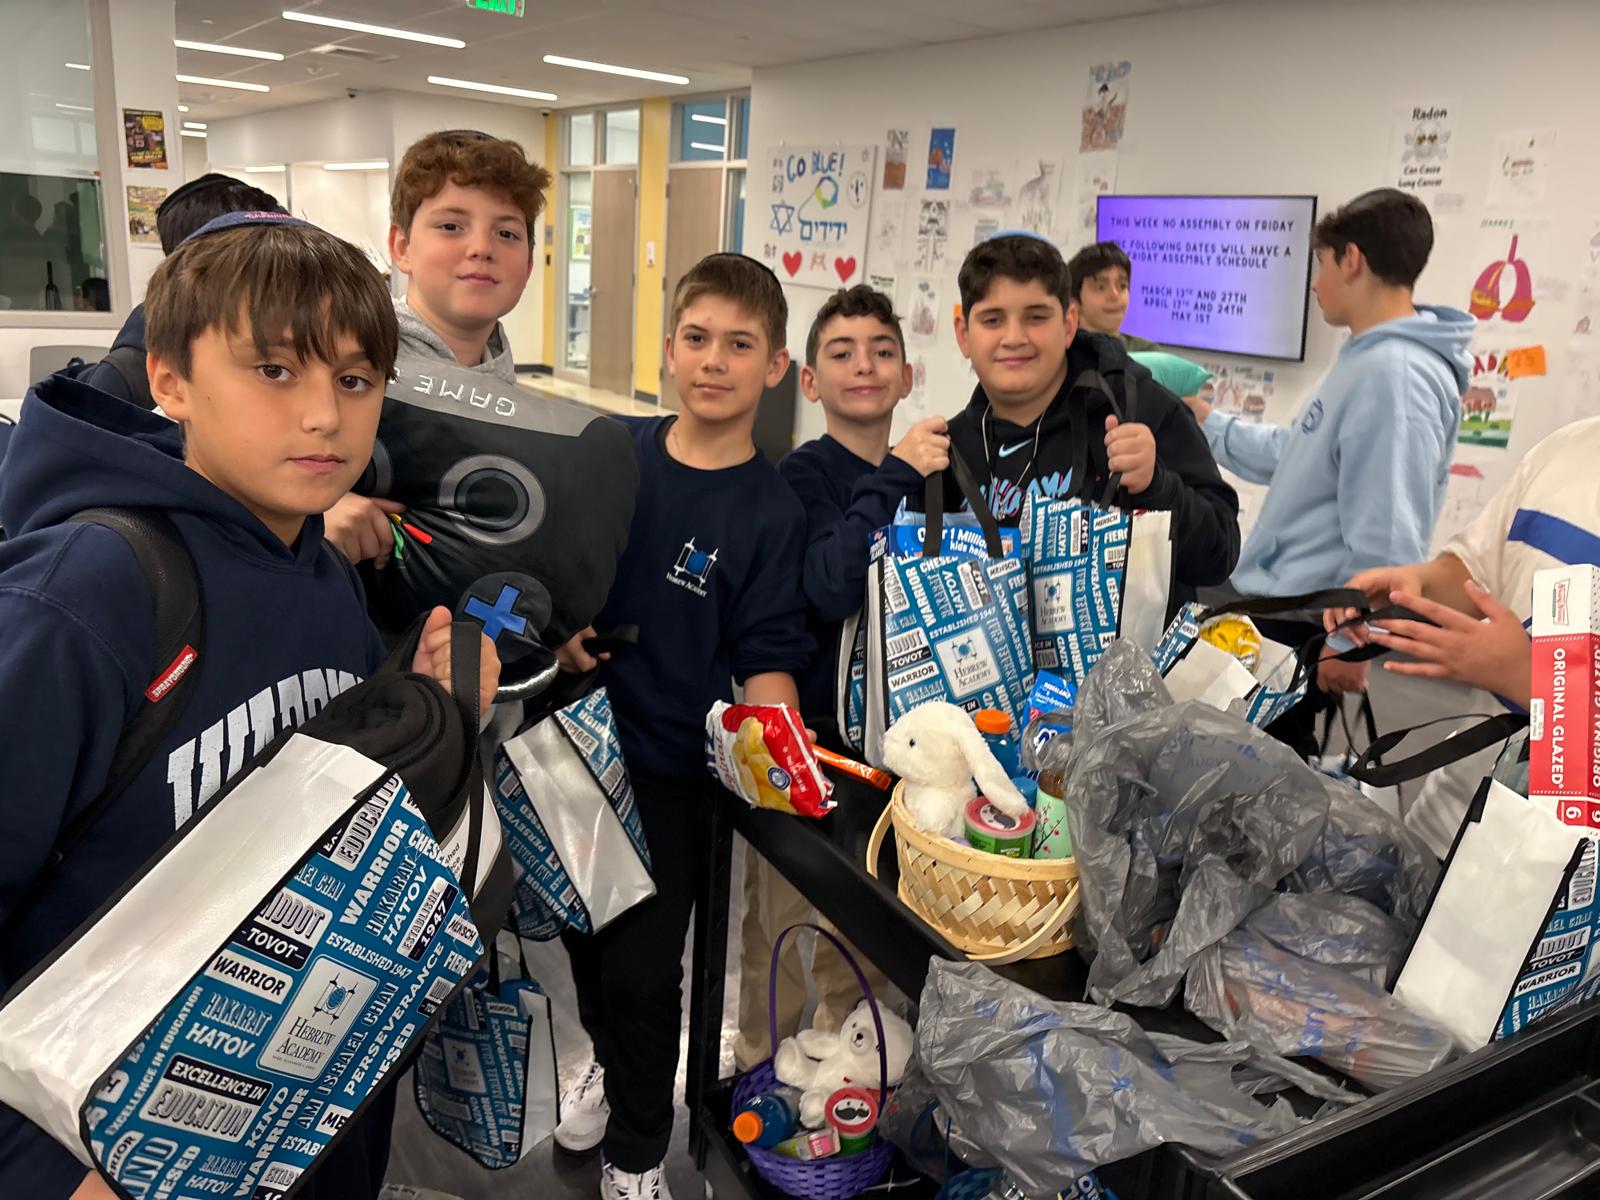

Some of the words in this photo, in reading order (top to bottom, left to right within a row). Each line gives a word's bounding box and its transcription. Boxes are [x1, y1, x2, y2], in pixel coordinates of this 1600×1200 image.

[1412, 106, 1447, 121] Radon
[787, 154, 806, 182] GO
[1111, 217, 1130, 228] THIS
[1134, 217, 1158, 229] WEEK
[1163, 218, 1176, 229] NO
[1180, 218, 1231, 230] ASSEMBLY
[1236, 219, 1250, 231] ON
[1255, 220, 1294, 232] FRIDAY
[1131, 240, 1181, 252] FOLLOWING
[1186, 242, 1216, 253] DATES
[1221, 244, 1246, 256] WILL
[1251, 245, 1279, 257] HAVE
[1284, 246, 1292, 257] A
[1162, 253, 1212, 266] ASSEMBLY
[1216, 256, 1268, 270] SCHEDULE
[1141, 285, 1172, 297] MARCH
[1197, 289, 1217, 301] AND
[1221, 291, 1247, 304] 27TH
[1144, 297, 1169, 309] APRIL
[1194, 301, 1213, 313] AND
[1217, 304, 1243, 316] 24TH
[1172, 311, 1191, 322] MAY
[1195, 313, 1211, 325] 1ST
[413, 374, 515, 417] GAME
[1058, 514, 1067, 557] HATOV
[972, 568, 989, 597] 1947
[1033, 561, 1073, 575] ESTABLISHED
[1074, 557, 1088, 567] 1947
[1091, 535, 1109, 627] PERSEVERANCE
[905, 566, 936, 628] WARRIOR
[942, 570, 966, 615] HATOV
[929, 615, 979, 640] ESTABLISHED
[979, 606, 997, 621] 1947
[994, 584, 1028, 672] PERSEVERANCE
[891, 665, 935, 688] WARRIOR
[892, 651, 923, 668] TOVOT
[1553, 648, 1566, 722] ORIGINAL
[1566, 806, 1582, 819] 6
[315, 872, 346, 902] CHAI
[339, 819, 409, 926] WARRIOR
[364, 854, 417, 937] HAKARAT
[382, 865, 429, 946] HATOV
[525, 874, 568, 921] WARRIOR
[259, 891, 326, 940] IDDOT
[421, 899, 447, 947] 1947
[247, 927, 299, 959] TOVOT
[325, 932, 394, 971] ESTABLISHED
[391, 963, 413, 981] 1947
[1531, 951, 1573, 971] TOVOT
[1532, 929, 1586, 961] IDDOT
[213, 956, 286, 996] WARRIOR
[1517, 965, 1576, 993] WARRIOR
[287, 1015, 337, 1047] HEBREW
[343, 941, 444, 1096] PERSEVERANCE
[185, 1021, 256, 1060] HATOV
[276, 1036, 327, 1064] ACADEMY
[295, 1097, 325, 1130] AM
[316, 1030, 368, 1096] ISRAEL
[361, 981, 400, 1028] CHAI
[104, 1065, 159, 1137] EXCELLENCE
[151, 1051, 167, 1067] IN
[159, 985, 204, 1052] EDUCATION
[171, 1061, 251, 1098] EXCELLENCE
[249, 1086, 267, 1101] IN
[147, 1084, 253, 1138] EDUCATION
[245, 1086, 289, 1149] KIND
[232, 1087, 310, 1198] WARRIOR
[185, 1173, 234, 1195] HATOV
